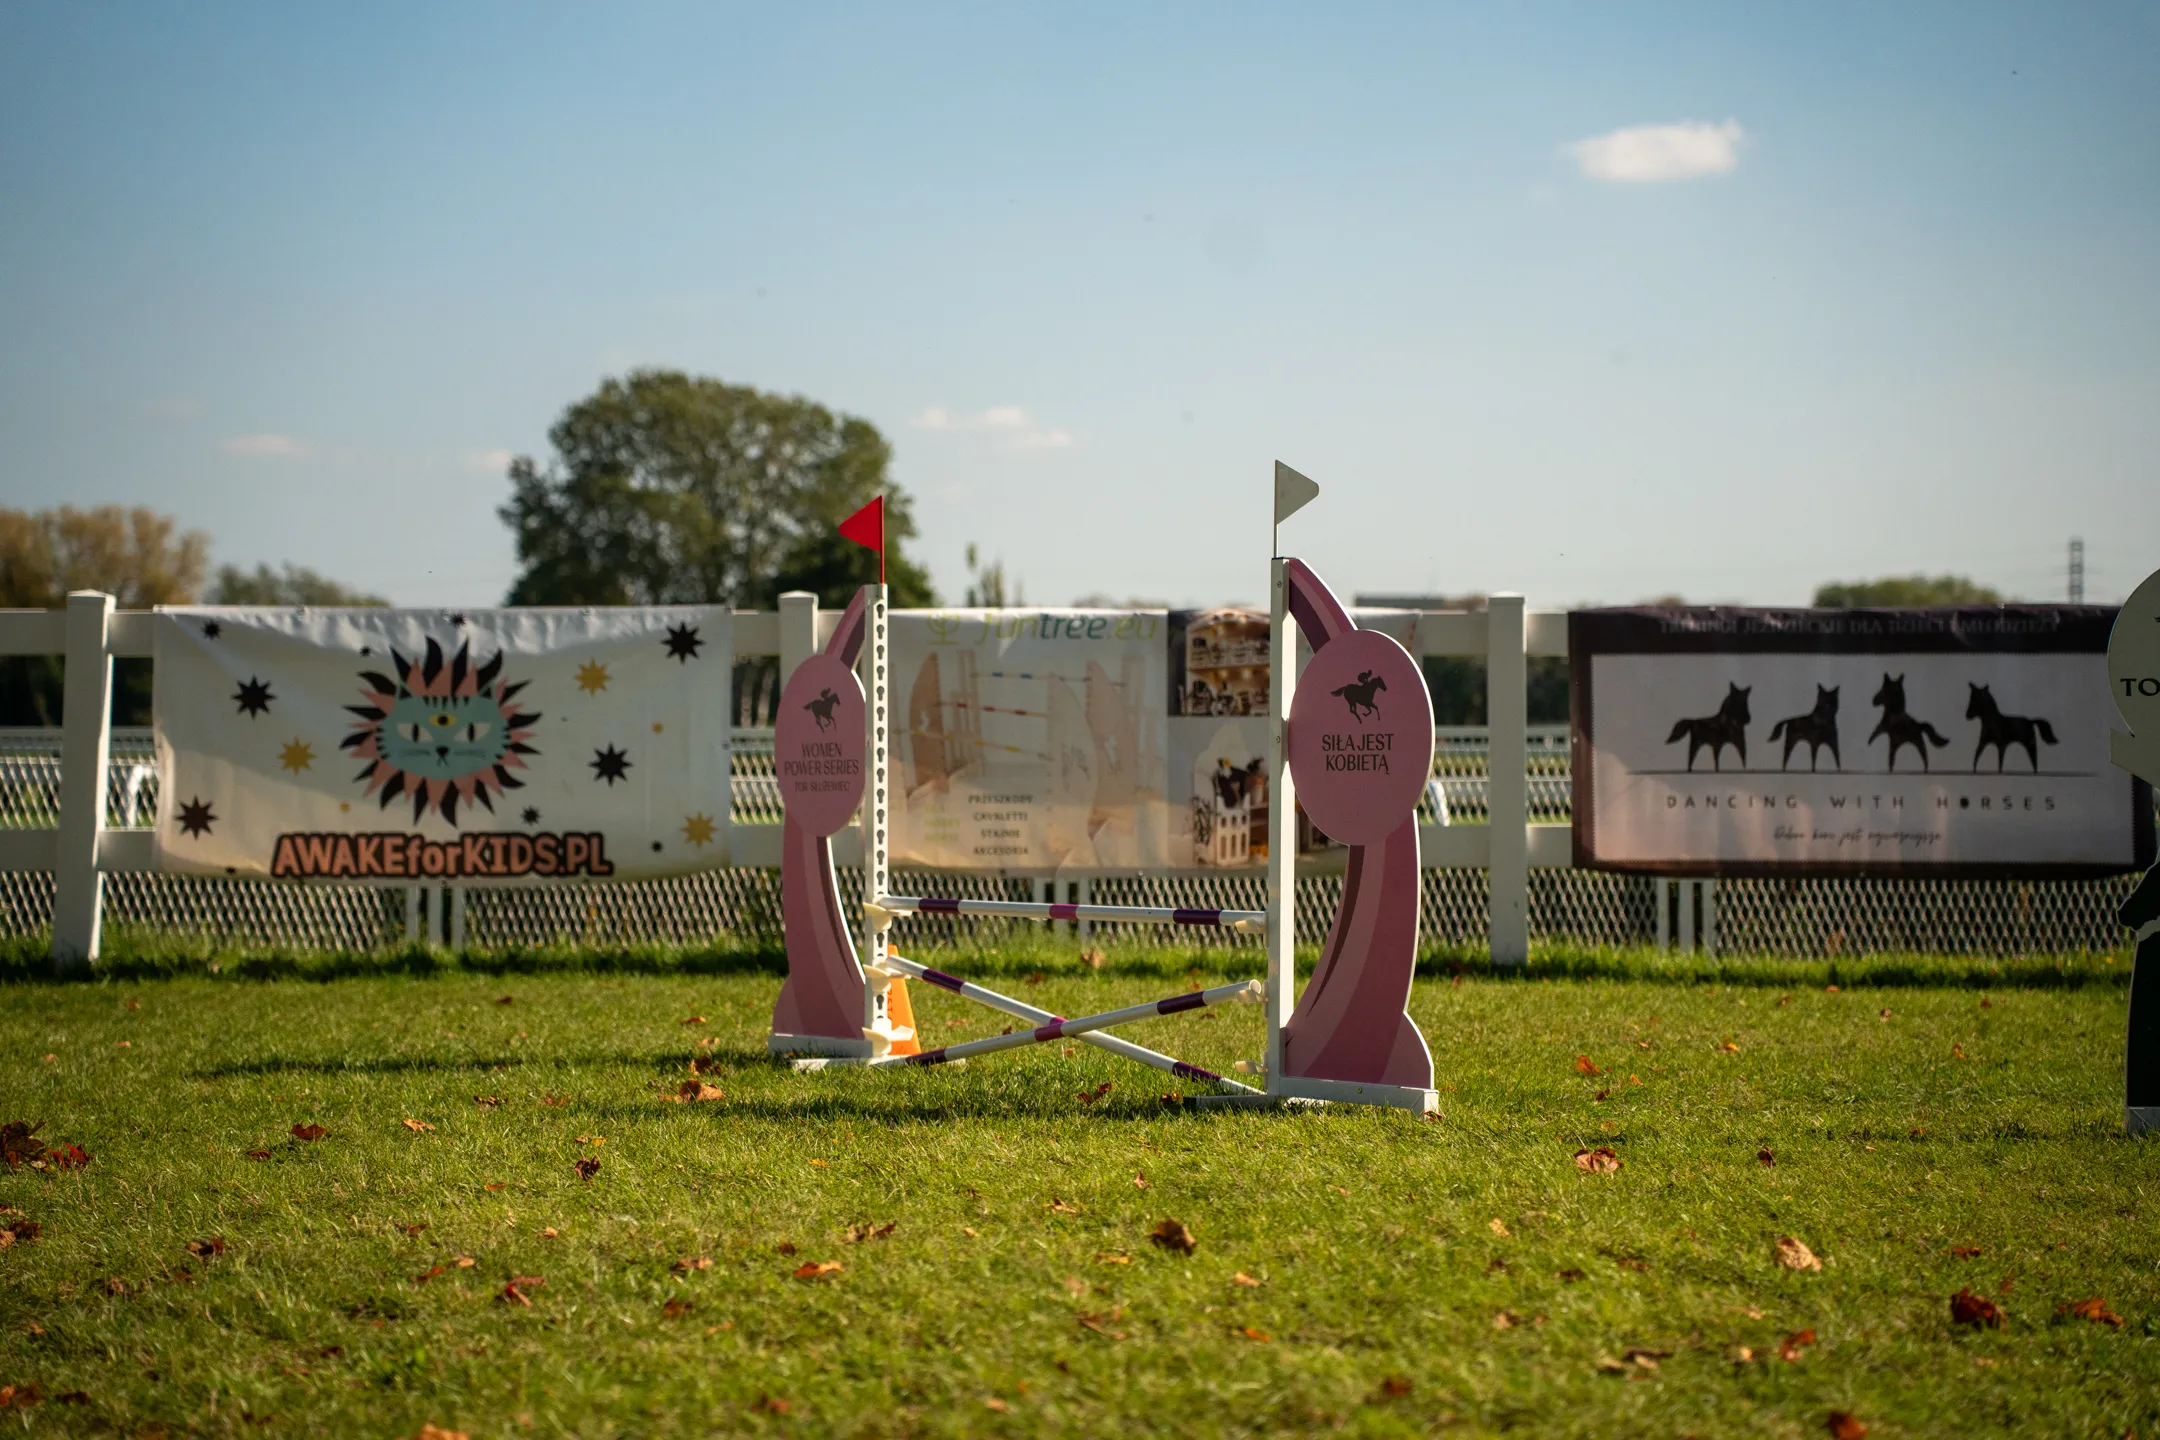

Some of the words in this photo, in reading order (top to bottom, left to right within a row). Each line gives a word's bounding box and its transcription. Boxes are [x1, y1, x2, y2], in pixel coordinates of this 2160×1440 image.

[2120, 678, 2160, 697] TO
[801, 742, 842, 758] WOMEN
[1322, 734, 1355, 751] SIŁA
[1357, 733, 1394, 751] JEST
[784, 760, 821, 776] POWER
[823, 759, 859, 775] SERIES
[1326, 754, 1389, 775] KOBIETĄ
[967, 794, 1034, 805] PRZESZKODY
[1667, 795, 1799, 810] DANCING
[1830, 795, 1906, 810] WITH
[1936, 796, 2056, 810] HORSES
[972, 811, 1028, 822] CAVALETTI
[273, 833, 613, 877] AWAKEforKIDS.PL
